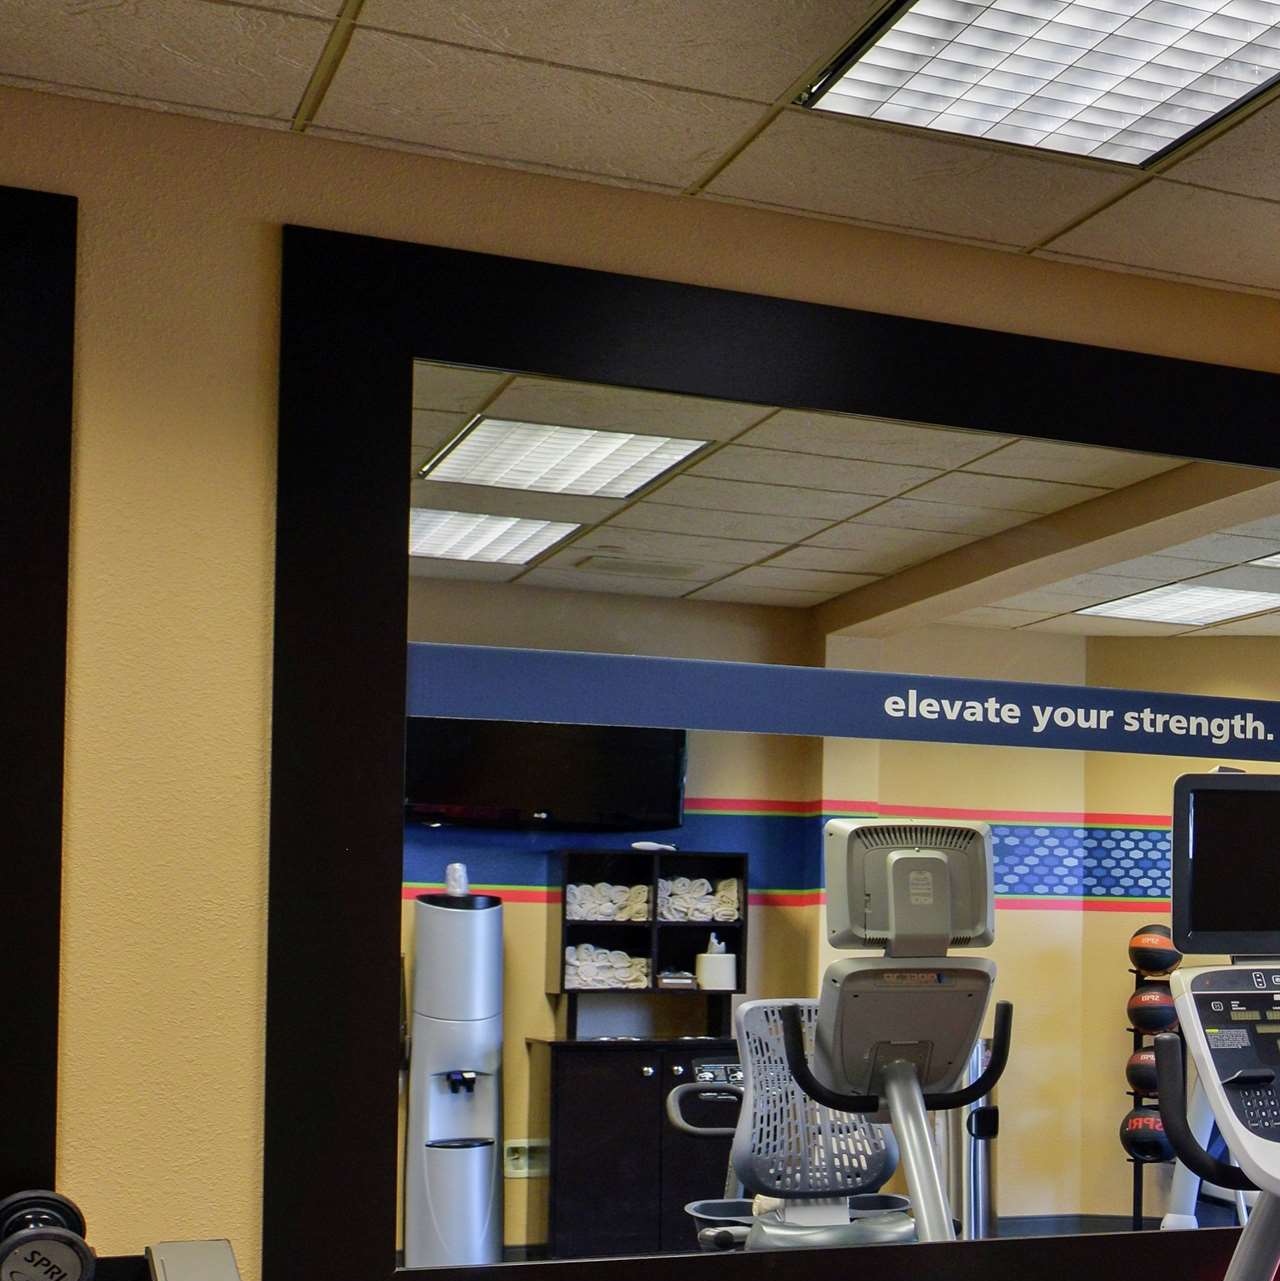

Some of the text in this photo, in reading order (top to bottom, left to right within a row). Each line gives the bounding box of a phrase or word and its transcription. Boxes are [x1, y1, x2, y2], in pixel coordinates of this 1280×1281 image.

[884, 689, 1275, 745] elevate your strength.
